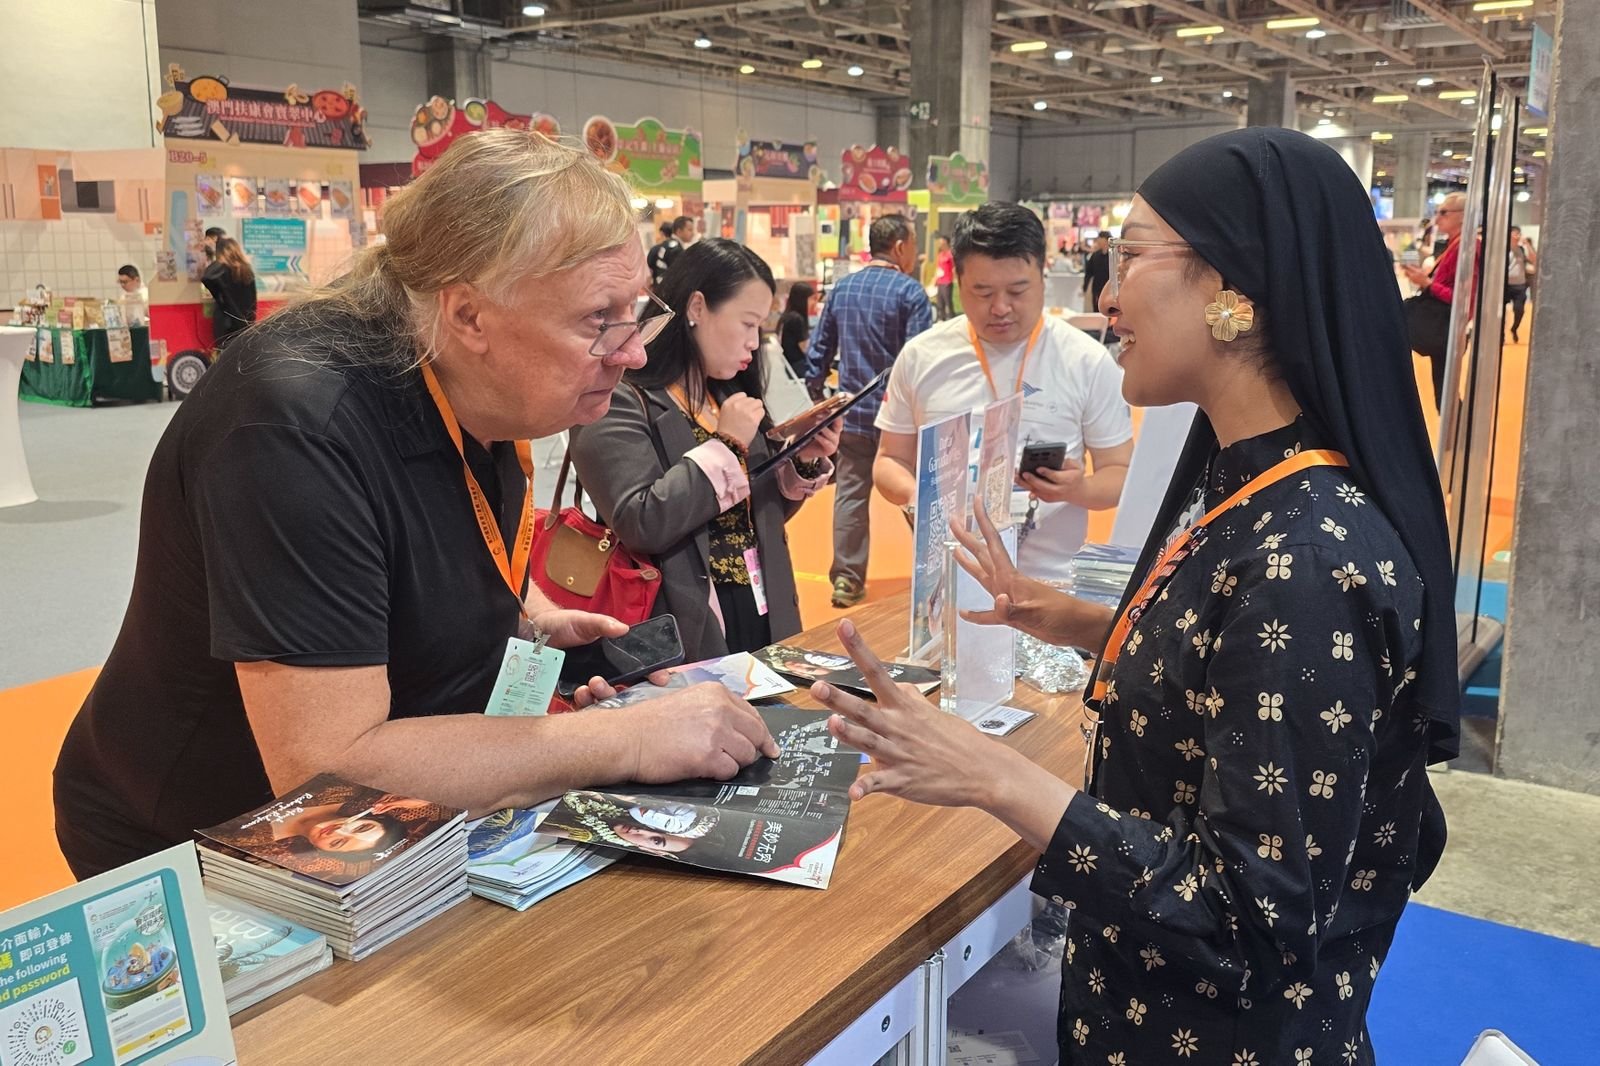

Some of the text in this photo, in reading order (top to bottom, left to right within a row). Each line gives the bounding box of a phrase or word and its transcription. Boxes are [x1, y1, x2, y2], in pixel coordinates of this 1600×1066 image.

[753, 820, 784, 864] 美妙无穷
[0, 922, 55, 952] 介面輸入
[20, 931, 73, 962] 即可登錄
[12, 963, 71, 1000] password
[15, 952, 68, 980] following
